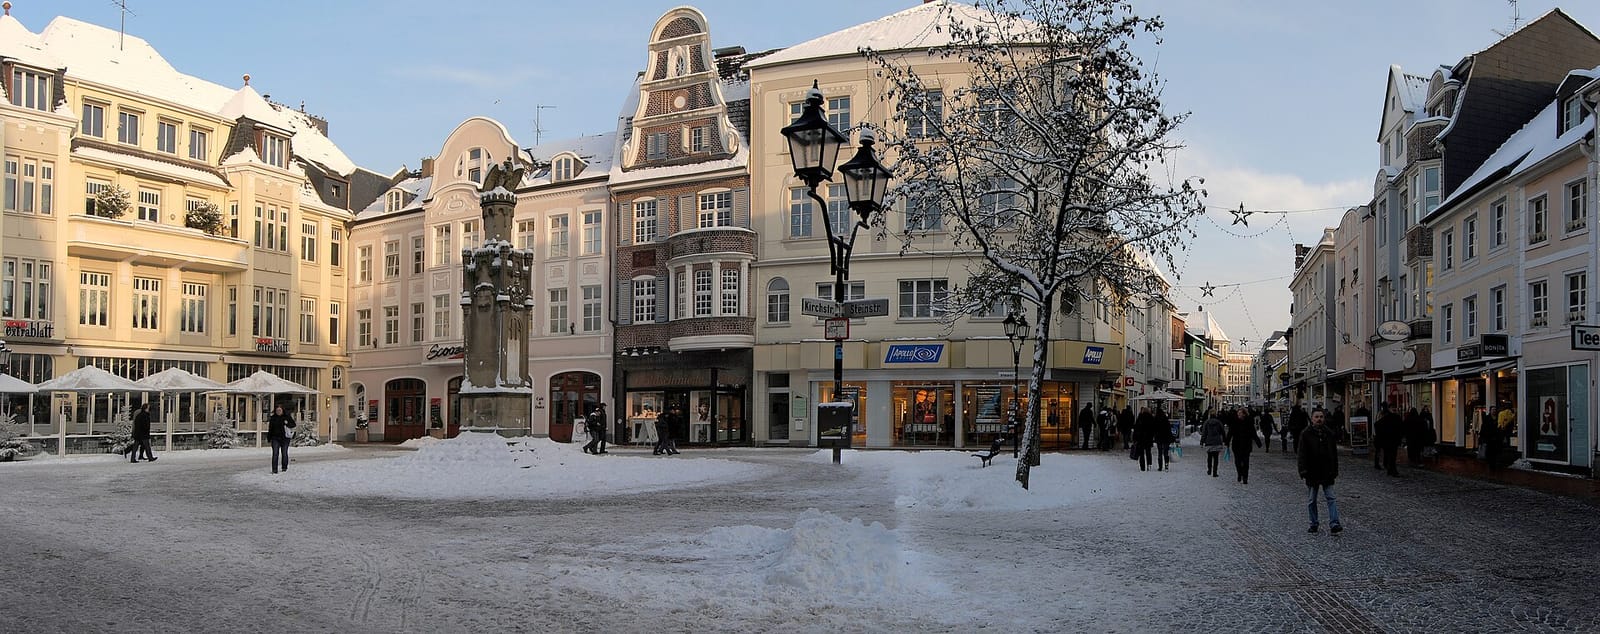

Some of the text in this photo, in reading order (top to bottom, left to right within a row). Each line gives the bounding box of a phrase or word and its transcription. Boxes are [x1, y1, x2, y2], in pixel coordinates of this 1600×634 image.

[804, 301, 835, 315] Kirchstr.
[850, 303, 881, 314] Steinstr.
[5, 321, 54, 338] extrablatt
[1577, 329, 1600, 346] Tee
[894, 348, 914, 357] APOLLO
